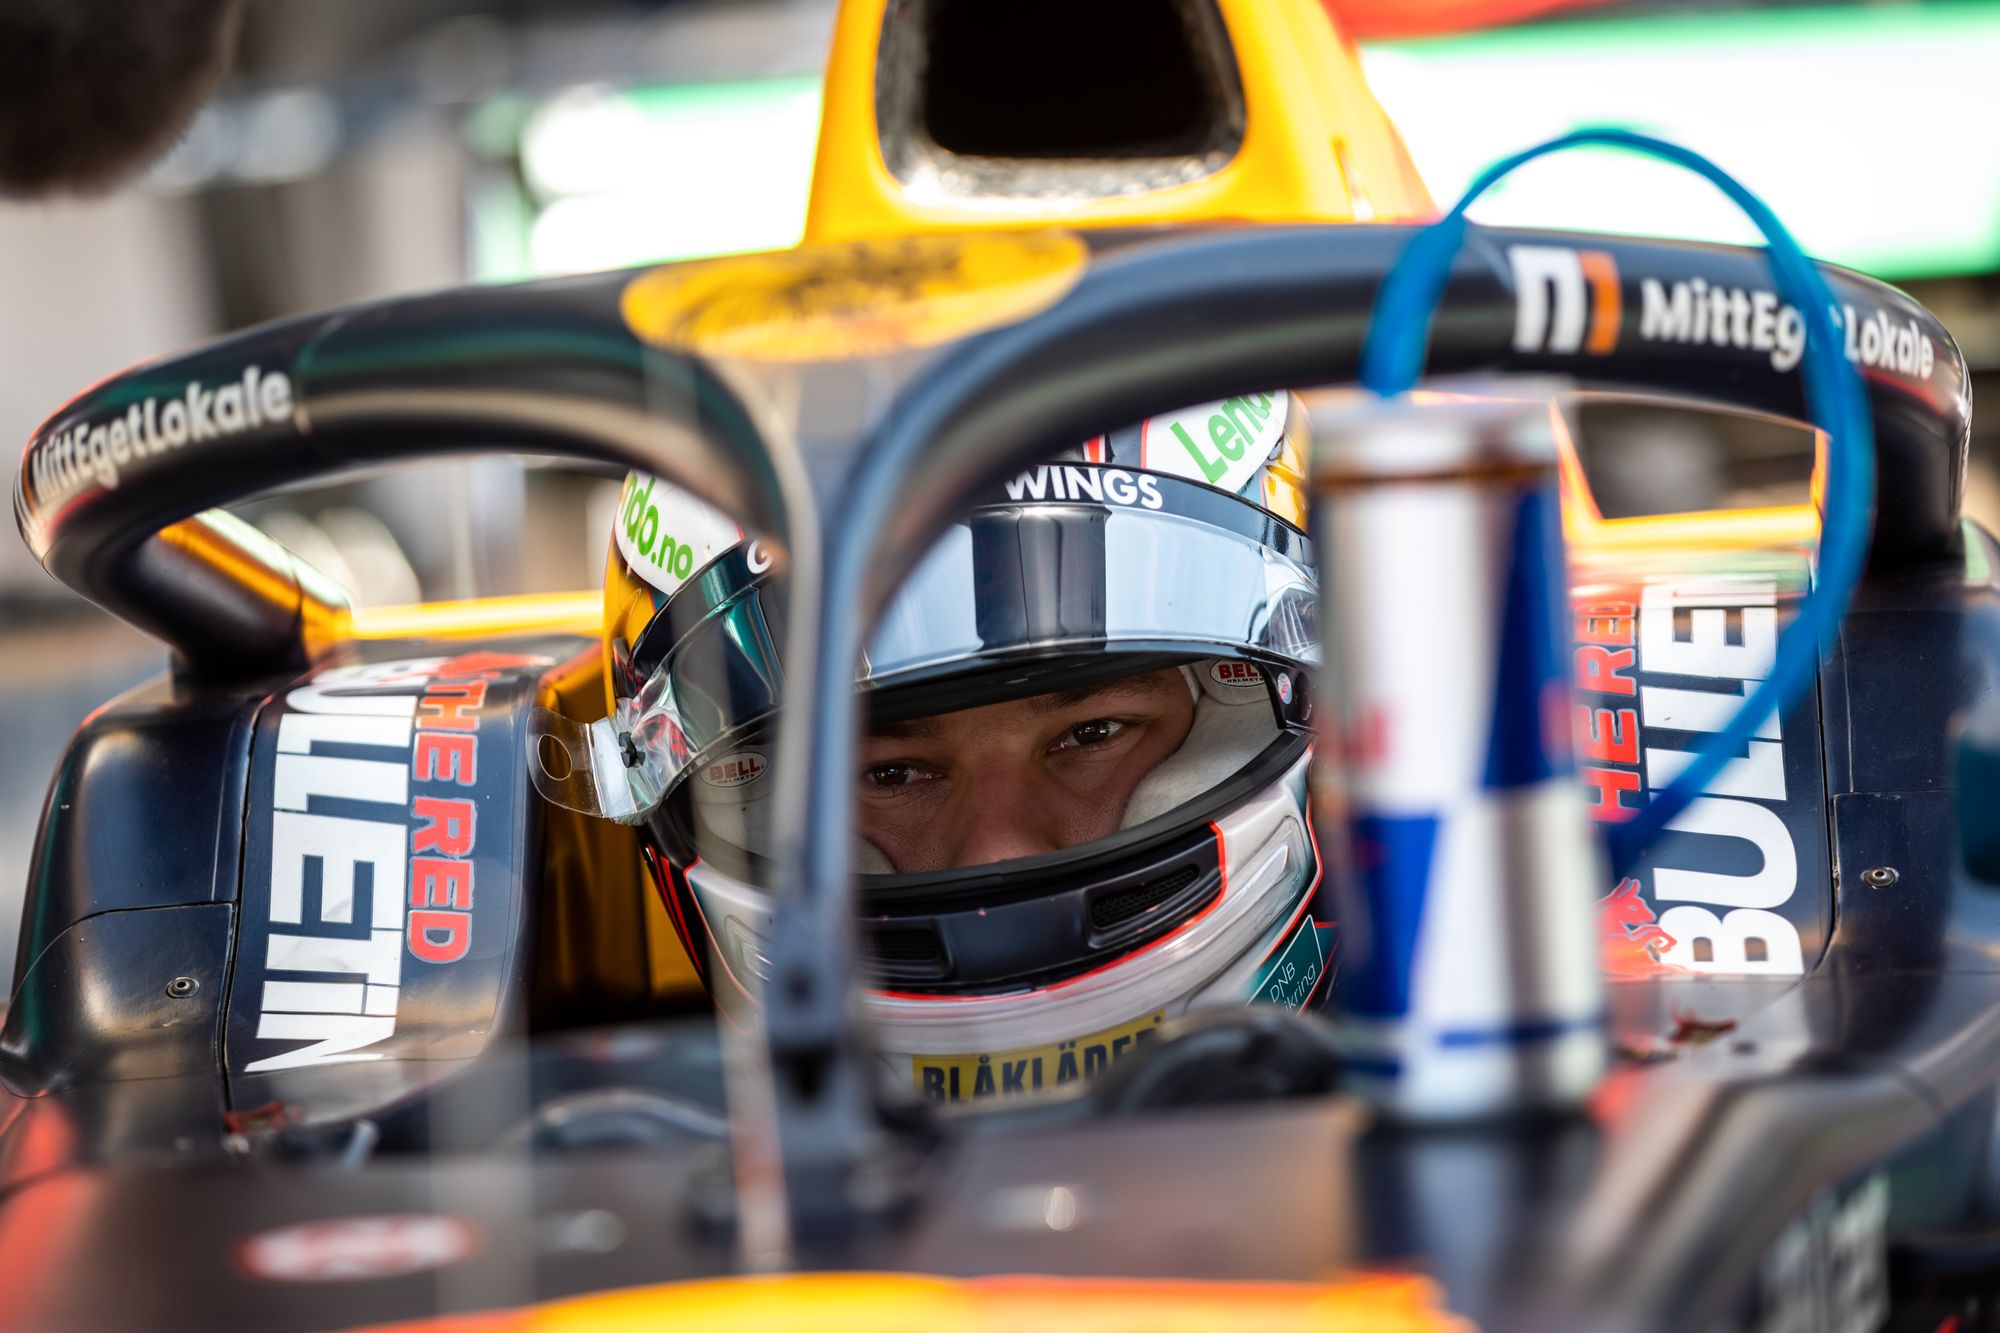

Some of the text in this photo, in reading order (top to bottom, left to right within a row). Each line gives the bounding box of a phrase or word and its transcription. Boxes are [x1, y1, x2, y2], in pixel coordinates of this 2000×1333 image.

[1640, 277, 1935, 380] MittEgLokale
[33, 365, 291, 504] MittEgetLokale
[1004, 465, 1163, 509] WINGS
[1218, 661, 1264, 680] BEL
[709, 757, 761, 781] BELL
[406, 795, 480, 963] RED
[1270, 962, 1296, 1004] DNB
[1284, 962, 1316, 1014] ikring
